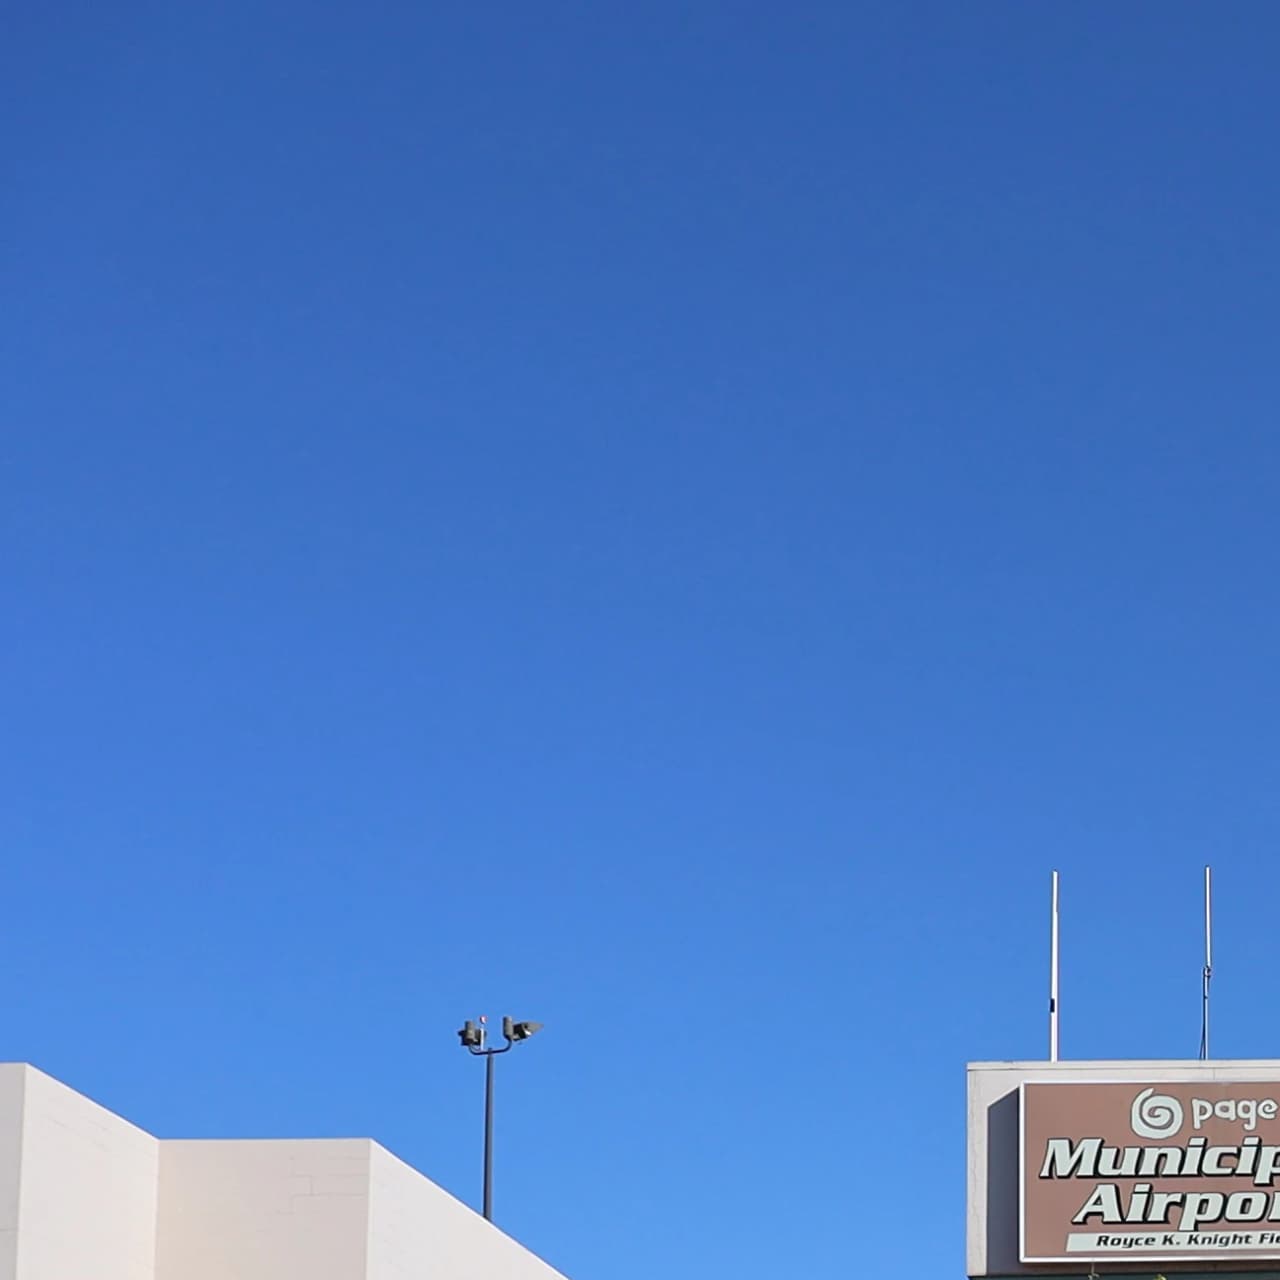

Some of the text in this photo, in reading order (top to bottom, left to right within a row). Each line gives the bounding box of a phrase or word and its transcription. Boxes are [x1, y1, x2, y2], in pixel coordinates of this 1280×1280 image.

[1192, 1097, 1278, 1130] page
[1096, 1235, 1155, 1249] Royce
[1162, 1234, 1181, 1246] K.
[1187, 1233, 1252, 1249] Knight
